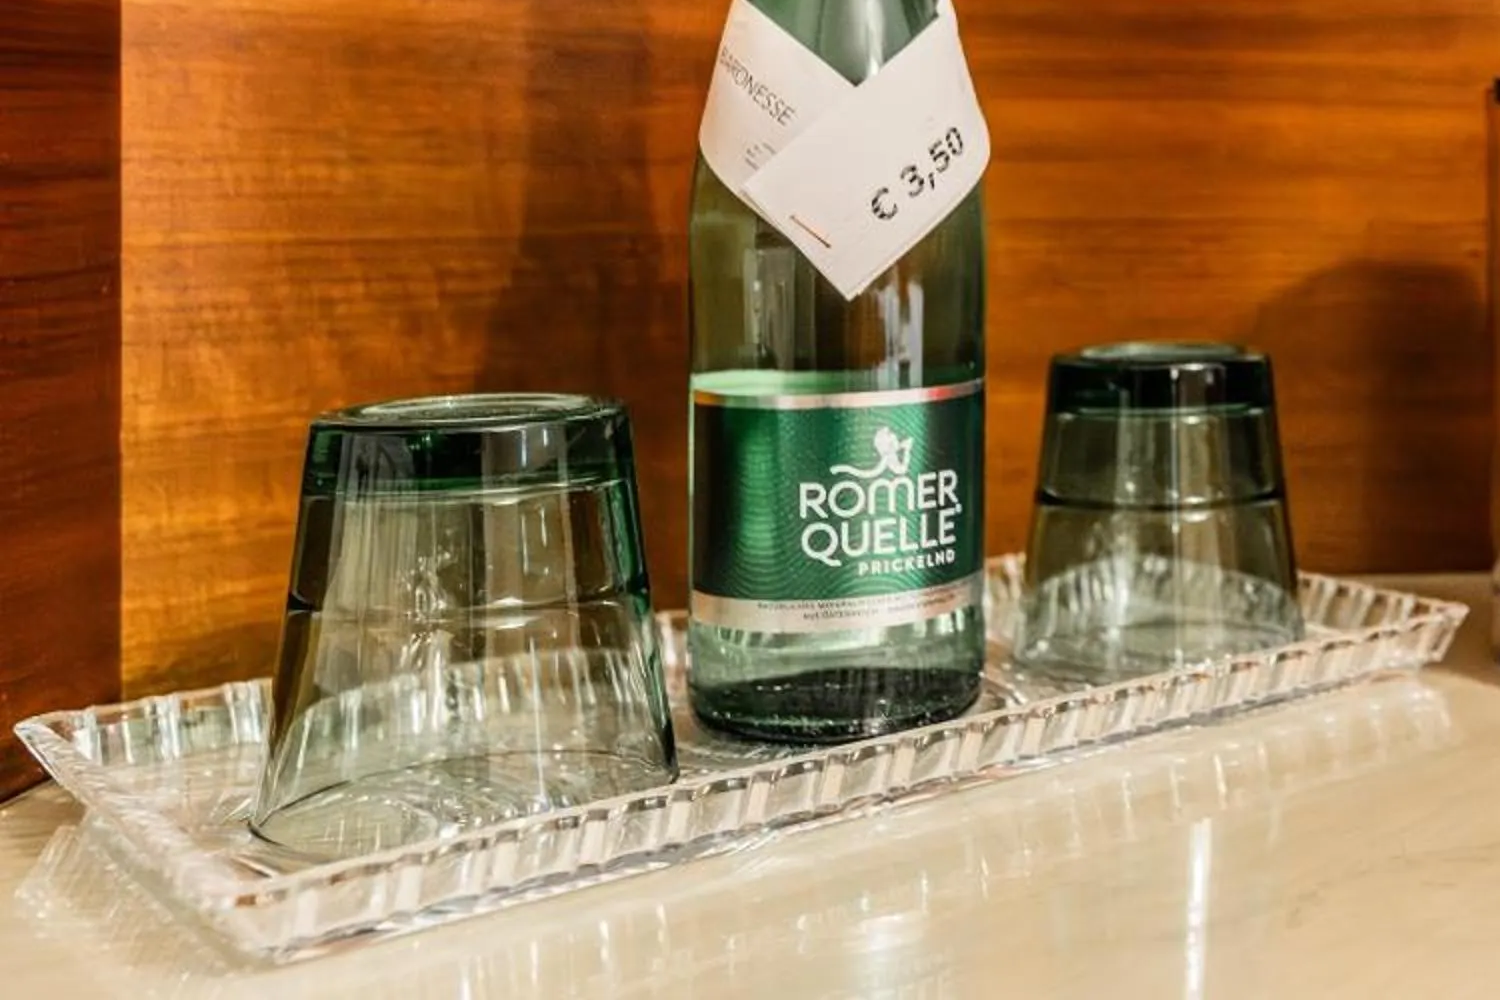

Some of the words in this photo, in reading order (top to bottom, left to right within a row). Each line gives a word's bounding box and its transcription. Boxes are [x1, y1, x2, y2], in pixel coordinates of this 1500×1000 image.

[900, 127, 964, 197] 3,50
[801, 508, 957, 567] QUELLE
[858, 549, 956, 576] PRICKELND
